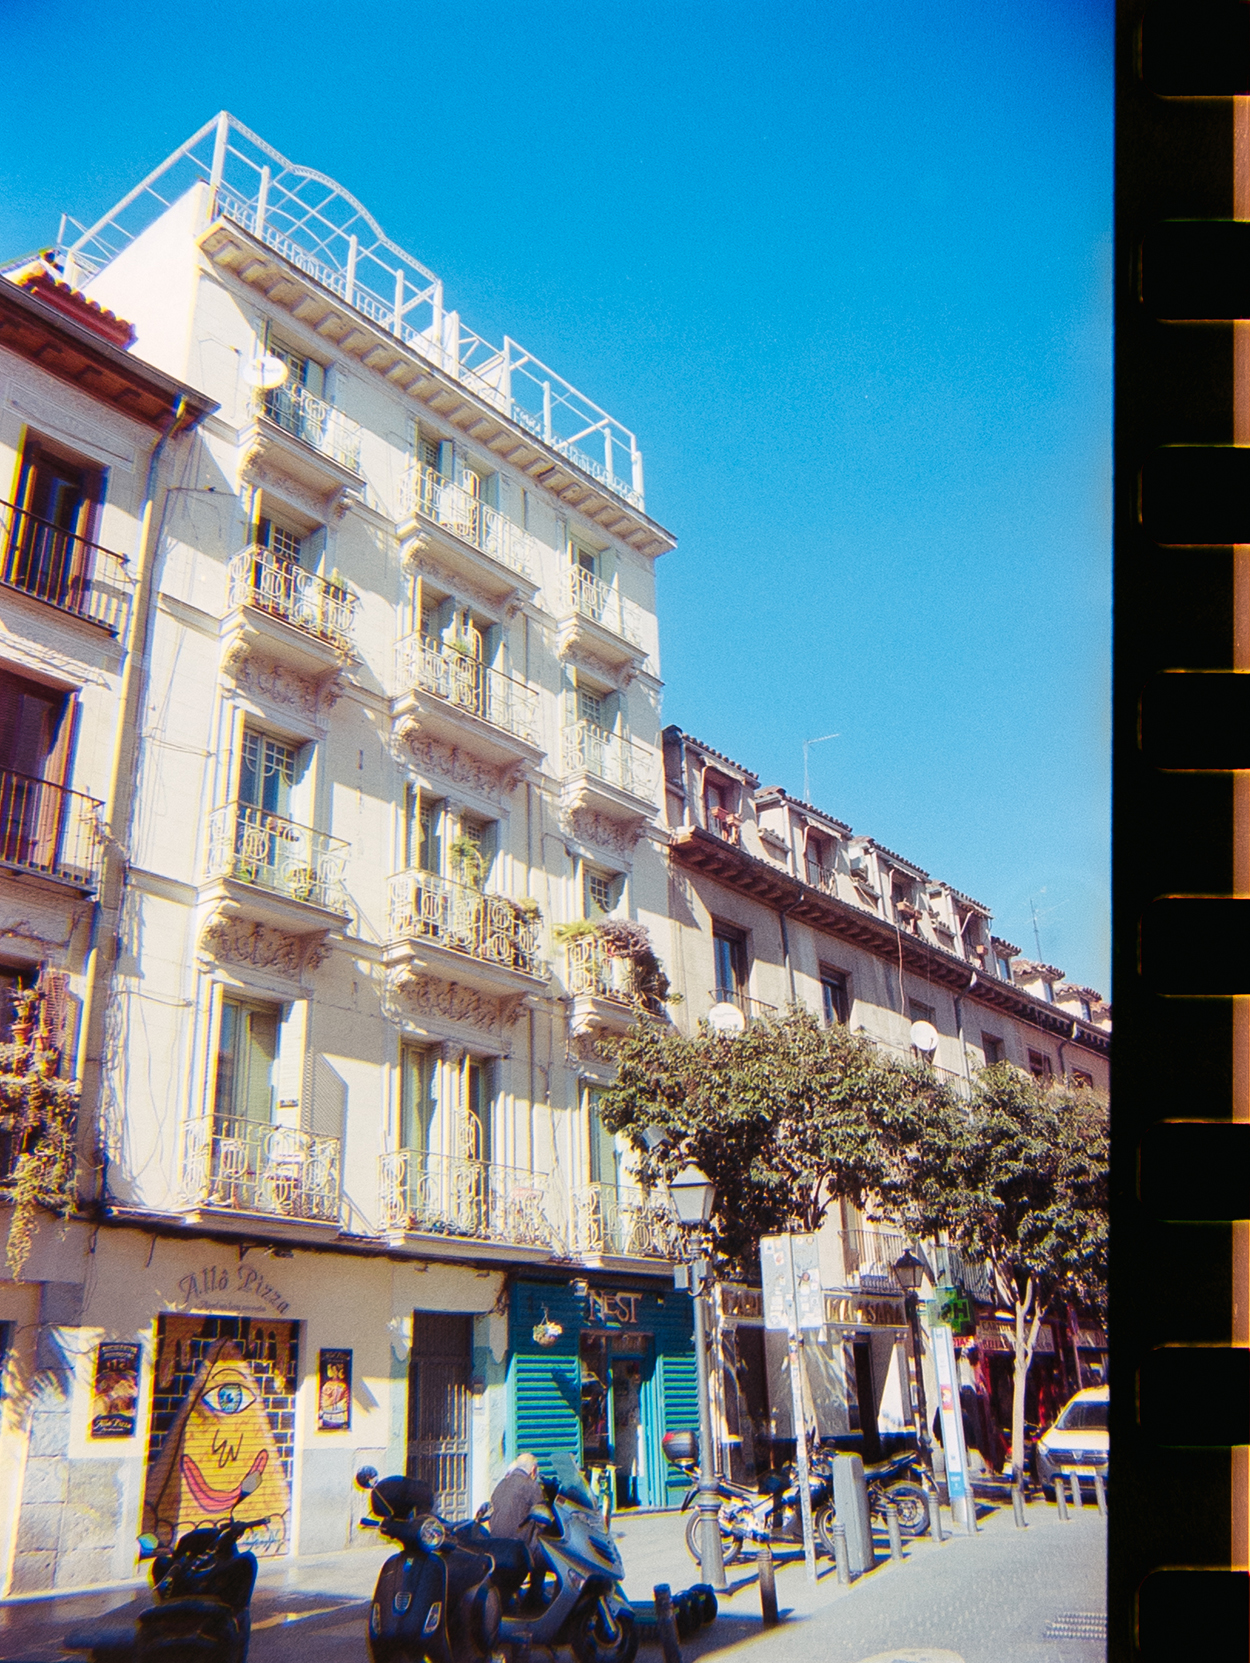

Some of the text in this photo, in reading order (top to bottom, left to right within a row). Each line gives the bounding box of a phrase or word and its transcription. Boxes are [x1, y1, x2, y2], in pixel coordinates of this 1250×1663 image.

[178, 1263, 291, 1315] Allô Pizza
[587, 1290, 643, 1323] NEST
